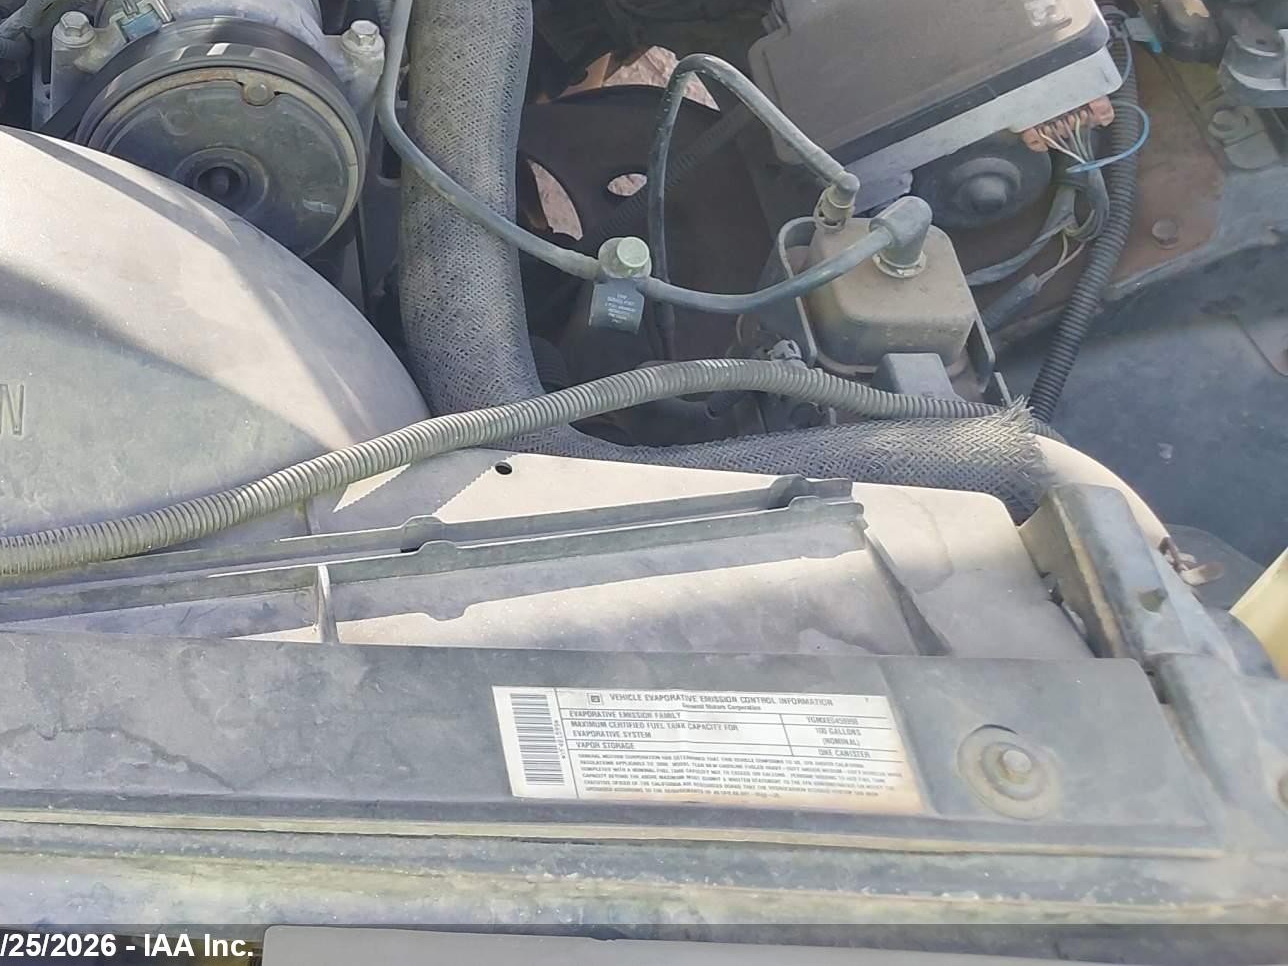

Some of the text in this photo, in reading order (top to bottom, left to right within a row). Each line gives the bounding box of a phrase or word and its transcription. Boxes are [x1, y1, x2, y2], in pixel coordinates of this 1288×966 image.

[609, 693, 643, 701] VEHICLE
[645, 694, 697, 703] EVAPORATIVE
[700, 695, 738, 703] EMISSION
[740, 696, 776, 705] CONTROL
[779, 697, 834, 706] INFORMATION
[569, 710, 617, 718] EVAPORATIVE
[654, 711, 681, 719] FAMILY
[570, 721, 607, 729] MAXIMUM
[608, 721, 645, 729] CERTIFIED
[646, 722, 666, 730] FUEL
[667, 722, 686, 730] TANK
[687, 723, 723, 731] CAPACITY
[572, 730, 621, 738] EVAPORATIVE
[601, 742, 634, 750] STORAGE
